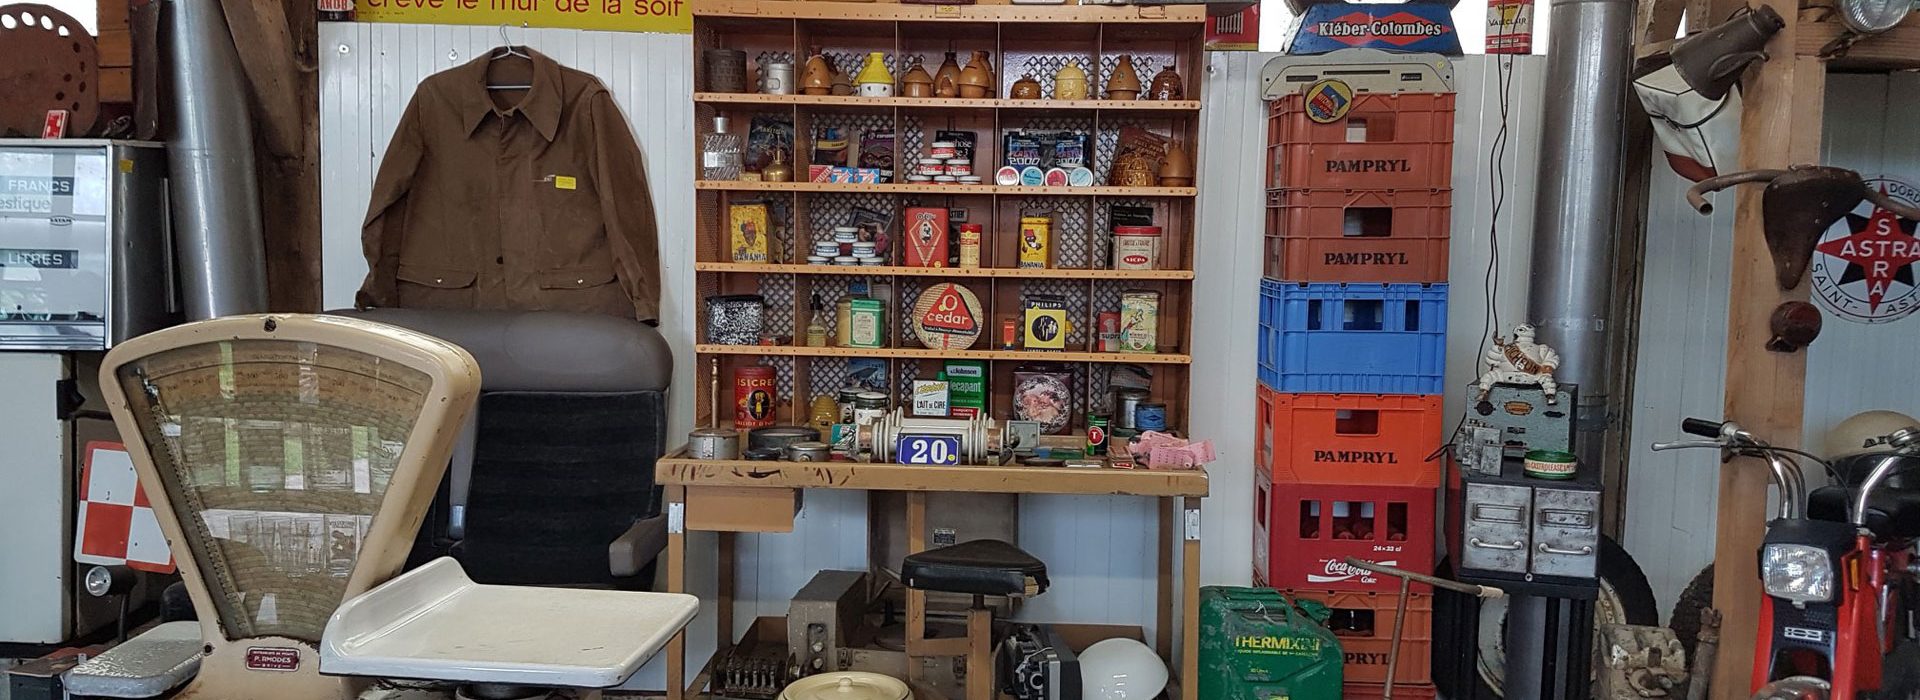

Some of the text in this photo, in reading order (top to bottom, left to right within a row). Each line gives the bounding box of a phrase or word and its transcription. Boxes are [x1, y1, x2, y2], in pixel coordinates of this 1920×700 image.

[602, 0, 622, 14] la
[634, 0, 683, 17] soif
[1318, 21, 1442, 37] Kléber-Colombes
[1008, 157, 1040, 165] 2000
[1326, 159, 1411, 173] PAMPRYL
[9, 179, 71, 192] FRANCS
[1840, 240, 1920, 258] ASTRA
[9, 253, 63, 265] LITRES
[734, 252, 767, 261] BANANIA
[1324, 252, 1408, 266] PAMPRYL
[927, 312, 969, 325] cedar
[916, 400, 929, 409] LAIT
[933, 401, 946, 409] CIRE
[910, 440, 948, 464] 20
[1314, 450, 1398, 464] PAMPRYL
[1324, 558, 1347, 575] Coca
